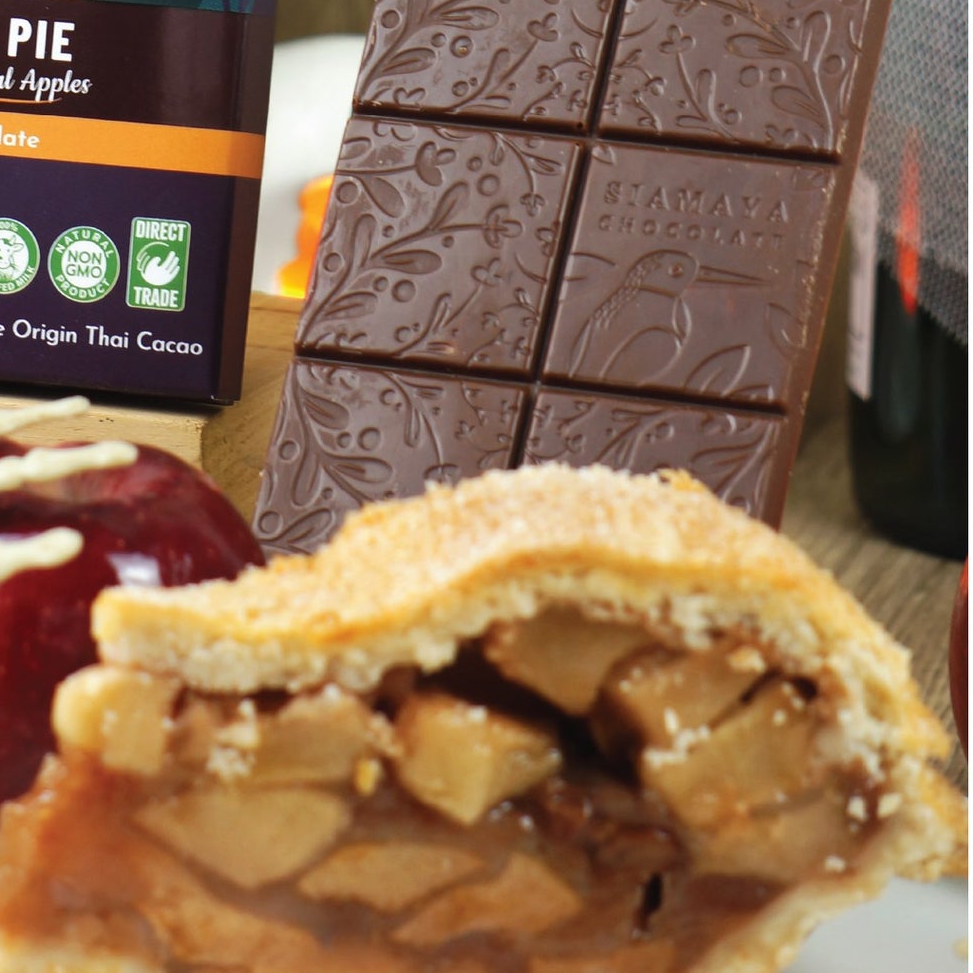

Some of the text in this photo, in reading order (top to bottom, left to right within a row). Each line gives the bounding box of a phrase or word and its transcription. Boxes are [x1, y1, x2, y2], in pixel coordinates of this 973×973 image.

[7, 17, 75, 62] PIE
[19, 68, 92, 102] Apples
[604, 180, 789, 223] SIAMAYA
[55, 230, 112, 259] NATURAL
[135, 220, 187, 242] DIRECT
[598, 214, 784, 248] CHOCOLATE
[66, 263, 102, 279] GMO
[67, 250, 102, 265] NON
[14, 265, 36, 289] MILK
[55, 274, 111, 299] PRODUCT
[133, 286, 179, 308] TRADE
[12, 318, 77, 346] Origin
[85, 325, 129, 349] Thai
[136, 331, 203, 355] Cacao
